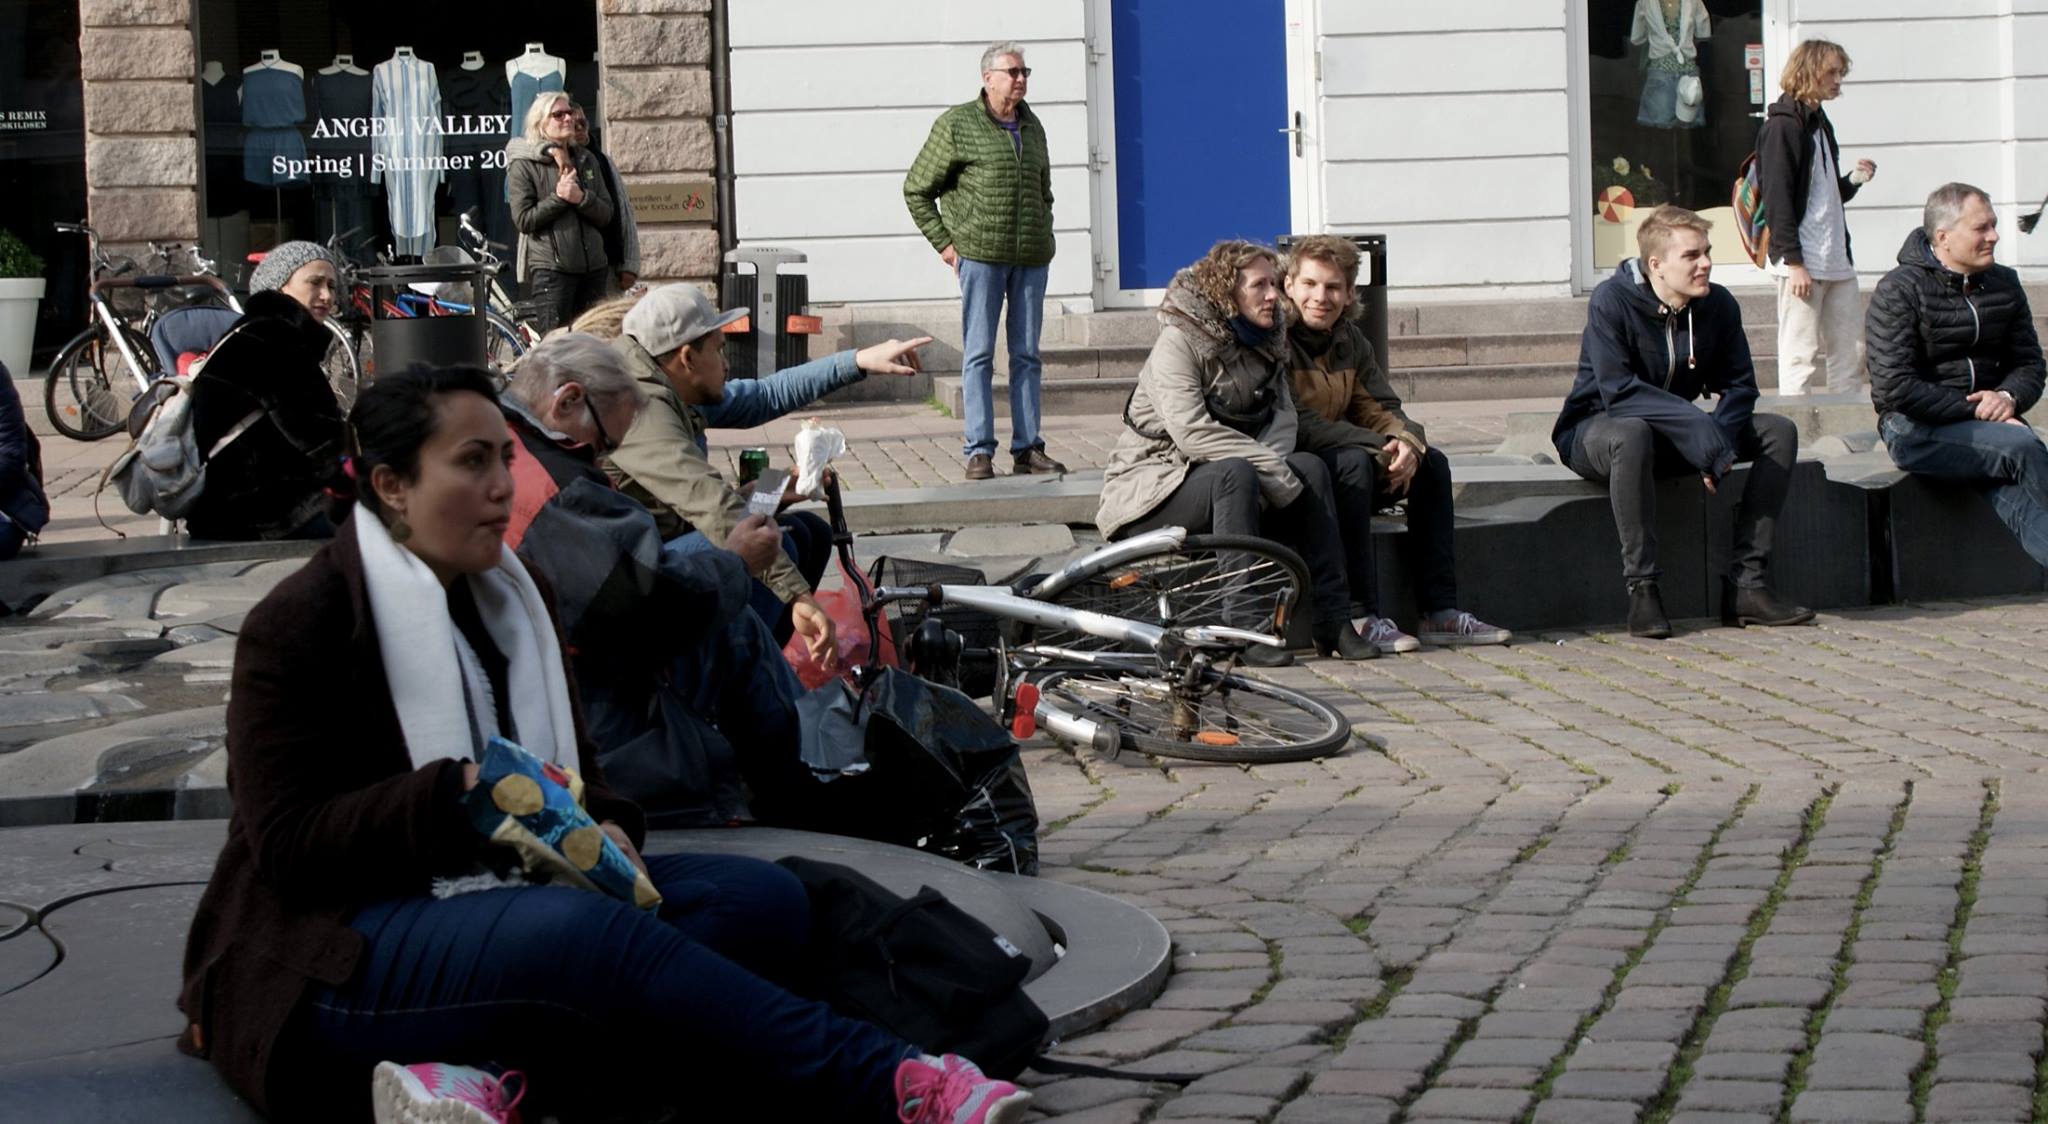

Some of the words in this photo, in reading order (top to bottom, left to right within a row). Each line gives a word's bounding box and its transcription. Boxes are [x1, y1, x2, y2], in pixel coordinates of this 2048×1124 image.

[9, 111, 46, 120] REMIX
[311, 117, 404, 138] ANGEL
[411, 114, 512, 136] VALLEY
[272, 154, 353, 179] Spring
[372, 152, 474, 173] Summer
[480, 149, 508, 170] 20
